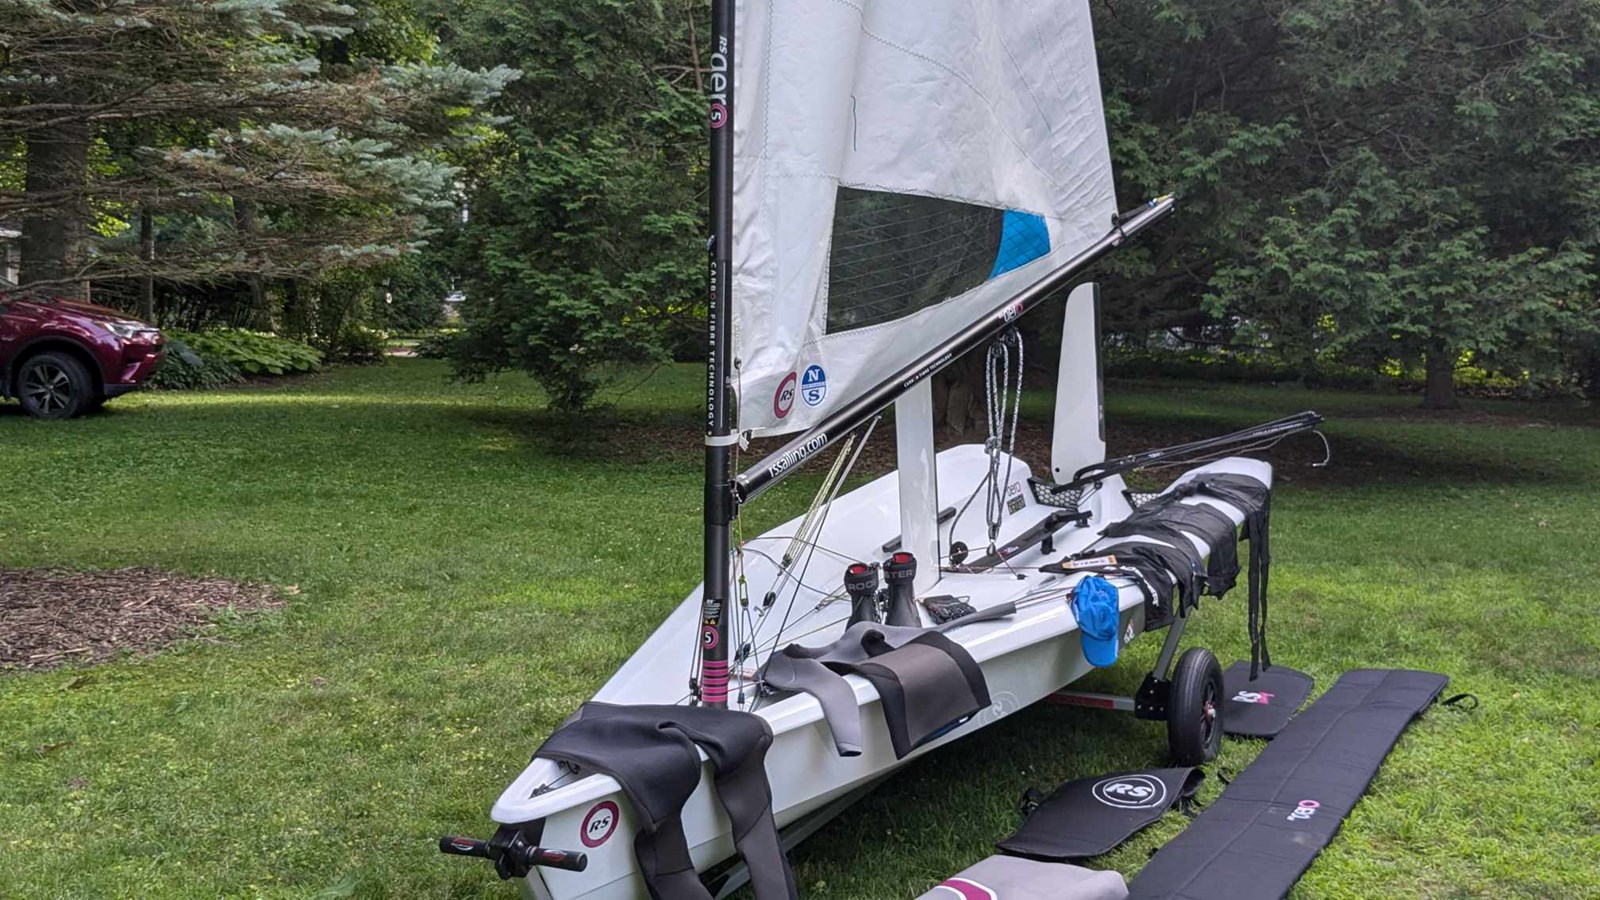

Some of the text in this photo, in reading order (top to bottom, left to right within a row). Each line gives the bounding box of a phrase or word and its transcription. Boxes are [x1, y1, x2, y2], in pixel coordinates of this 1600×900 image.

[709, 262, 717, 308] CARBON
[808, 369, 820, 382] N
[780, 388, 795, 402] RS
[808, 389, 820, 401] S
[704, 631, 712, 644] 5
[1105, 783, 1152, 797] RS
[588, 815, 611, 834] RS
